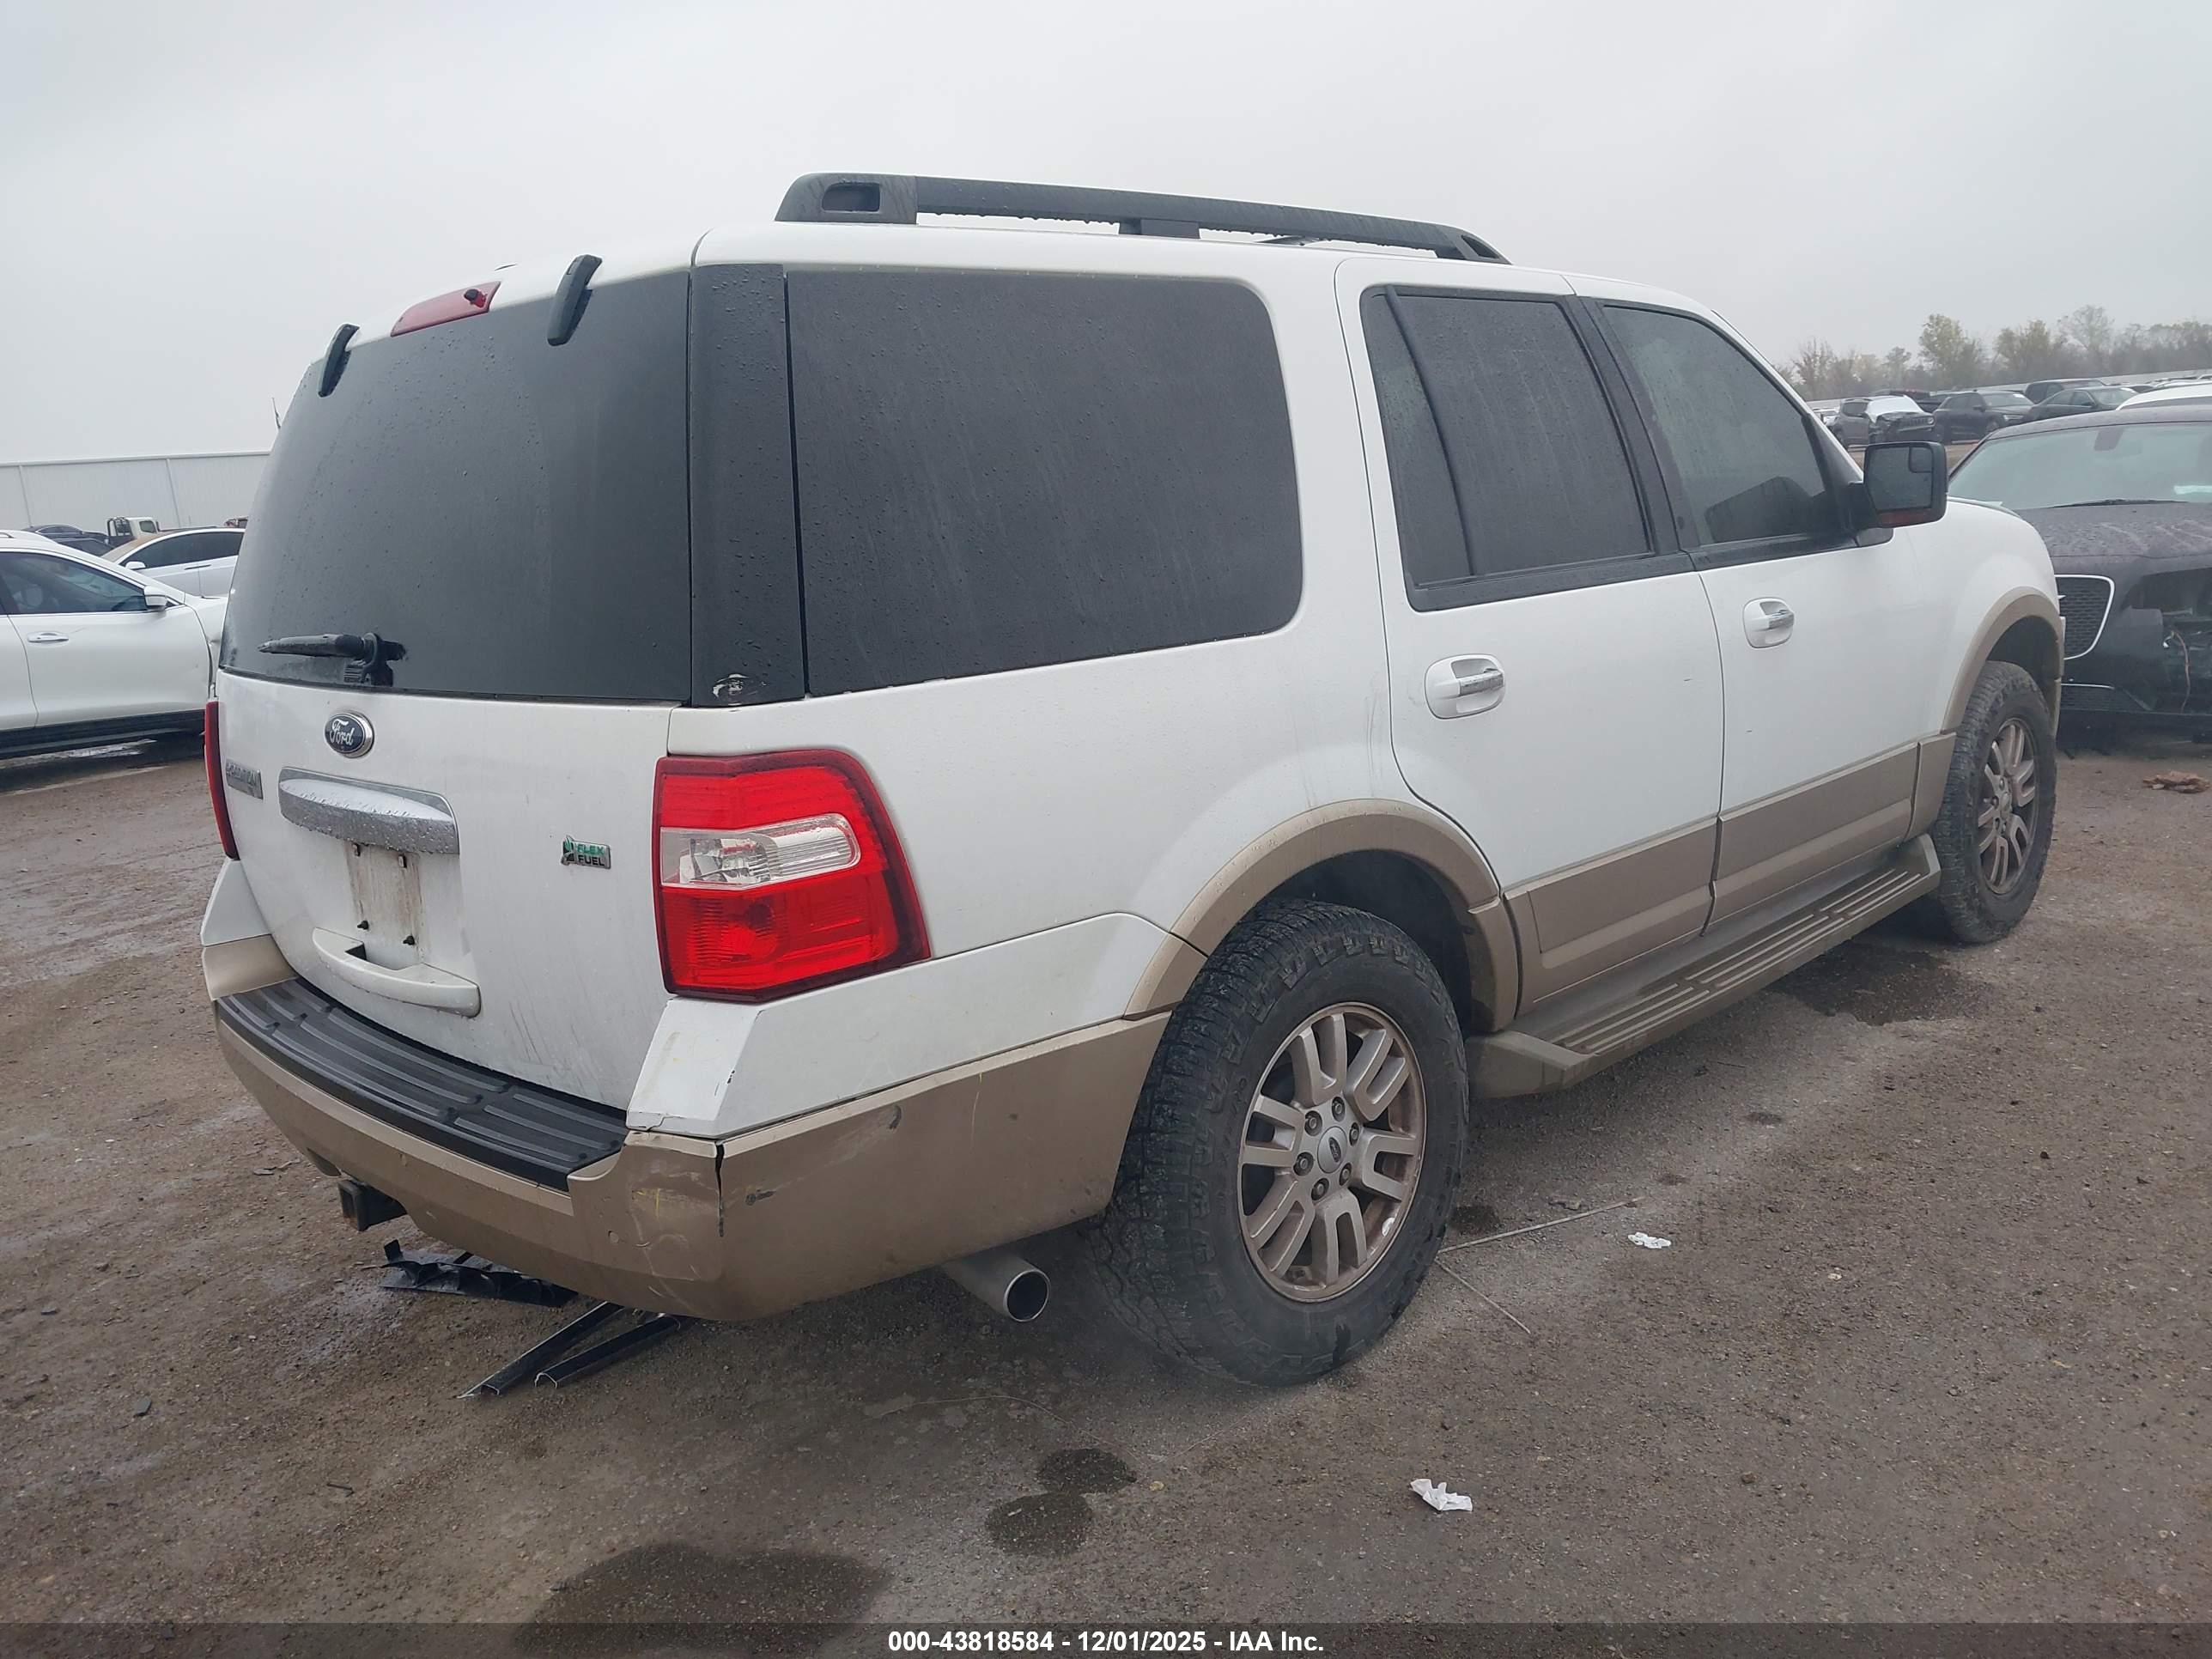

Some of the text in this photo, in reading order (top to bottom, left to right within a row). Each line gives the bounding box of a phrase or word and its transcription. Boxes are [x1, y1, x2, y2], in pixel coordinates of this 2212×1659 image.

[329, 719, 356, 746] Ford
[577, 842, 605, 855] FLEX
[578, 854, 605, 866] FUEL
